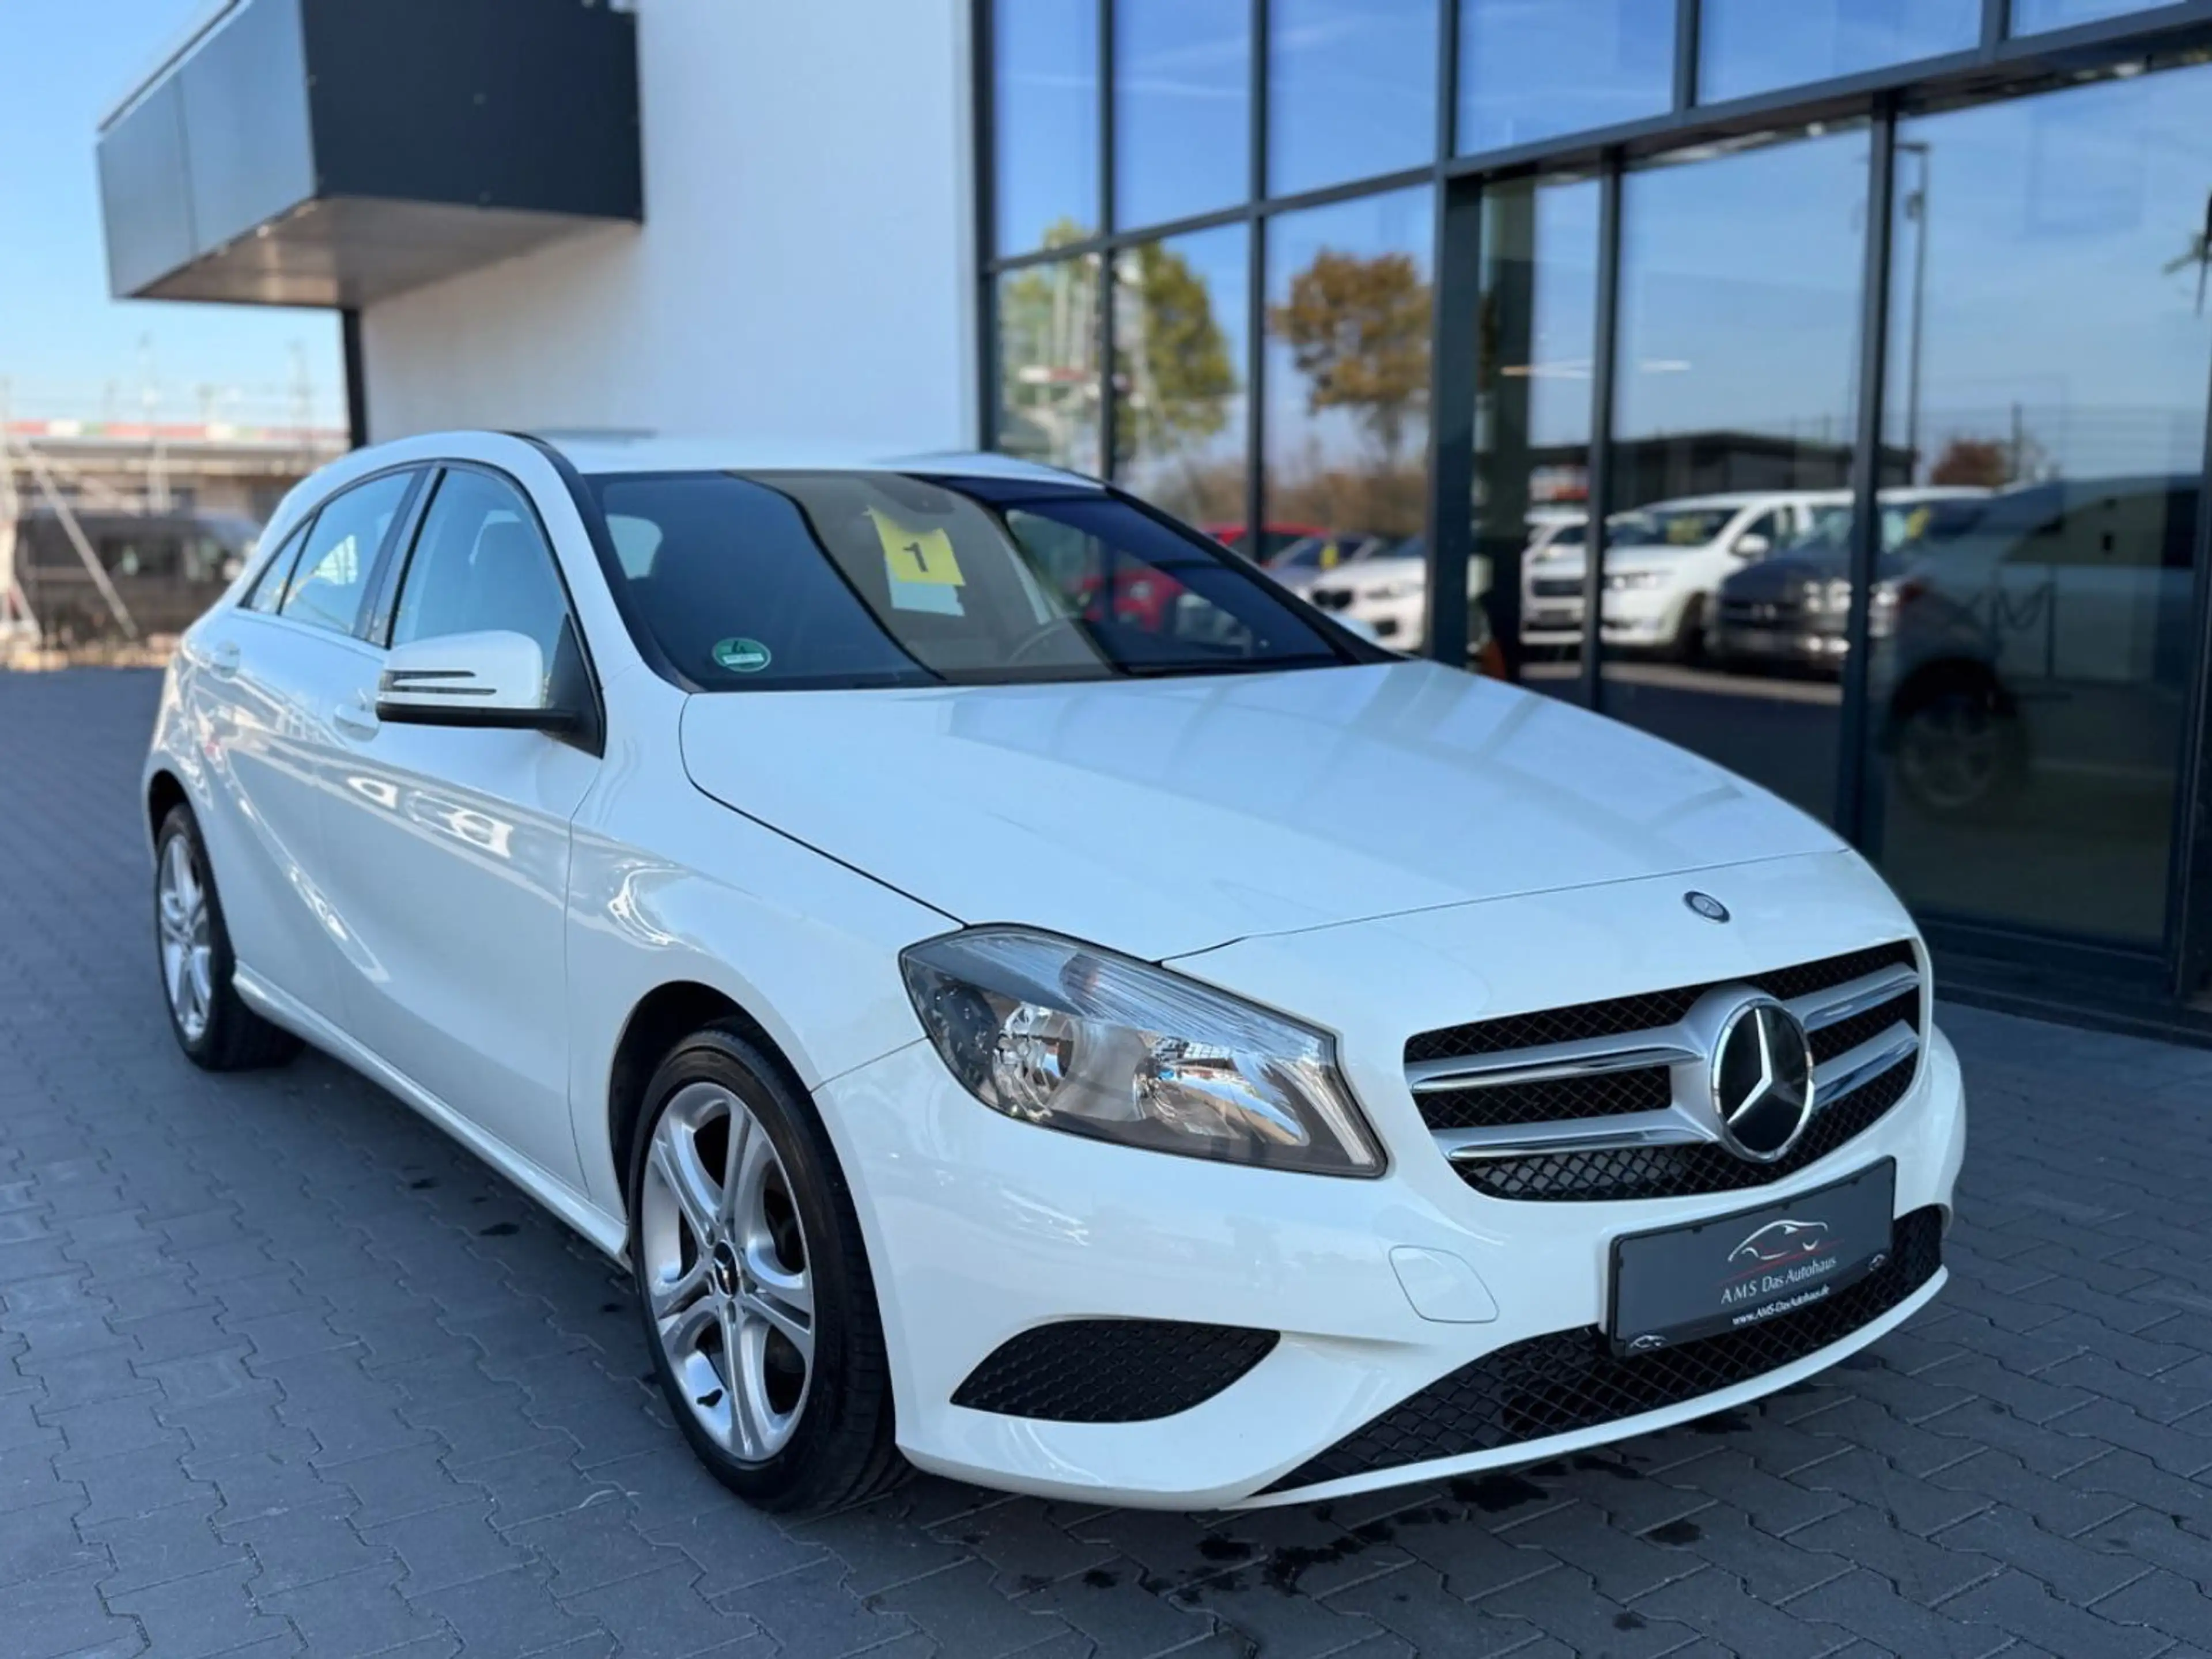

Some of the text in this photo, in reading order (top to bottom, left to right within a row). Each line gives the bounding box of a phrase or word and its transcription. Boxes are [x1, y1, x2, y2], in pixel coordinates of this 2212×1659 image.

[903, 541, 929, 573] 1
[1721, 1256, 1837, 1305] AMS Das Autohaus
